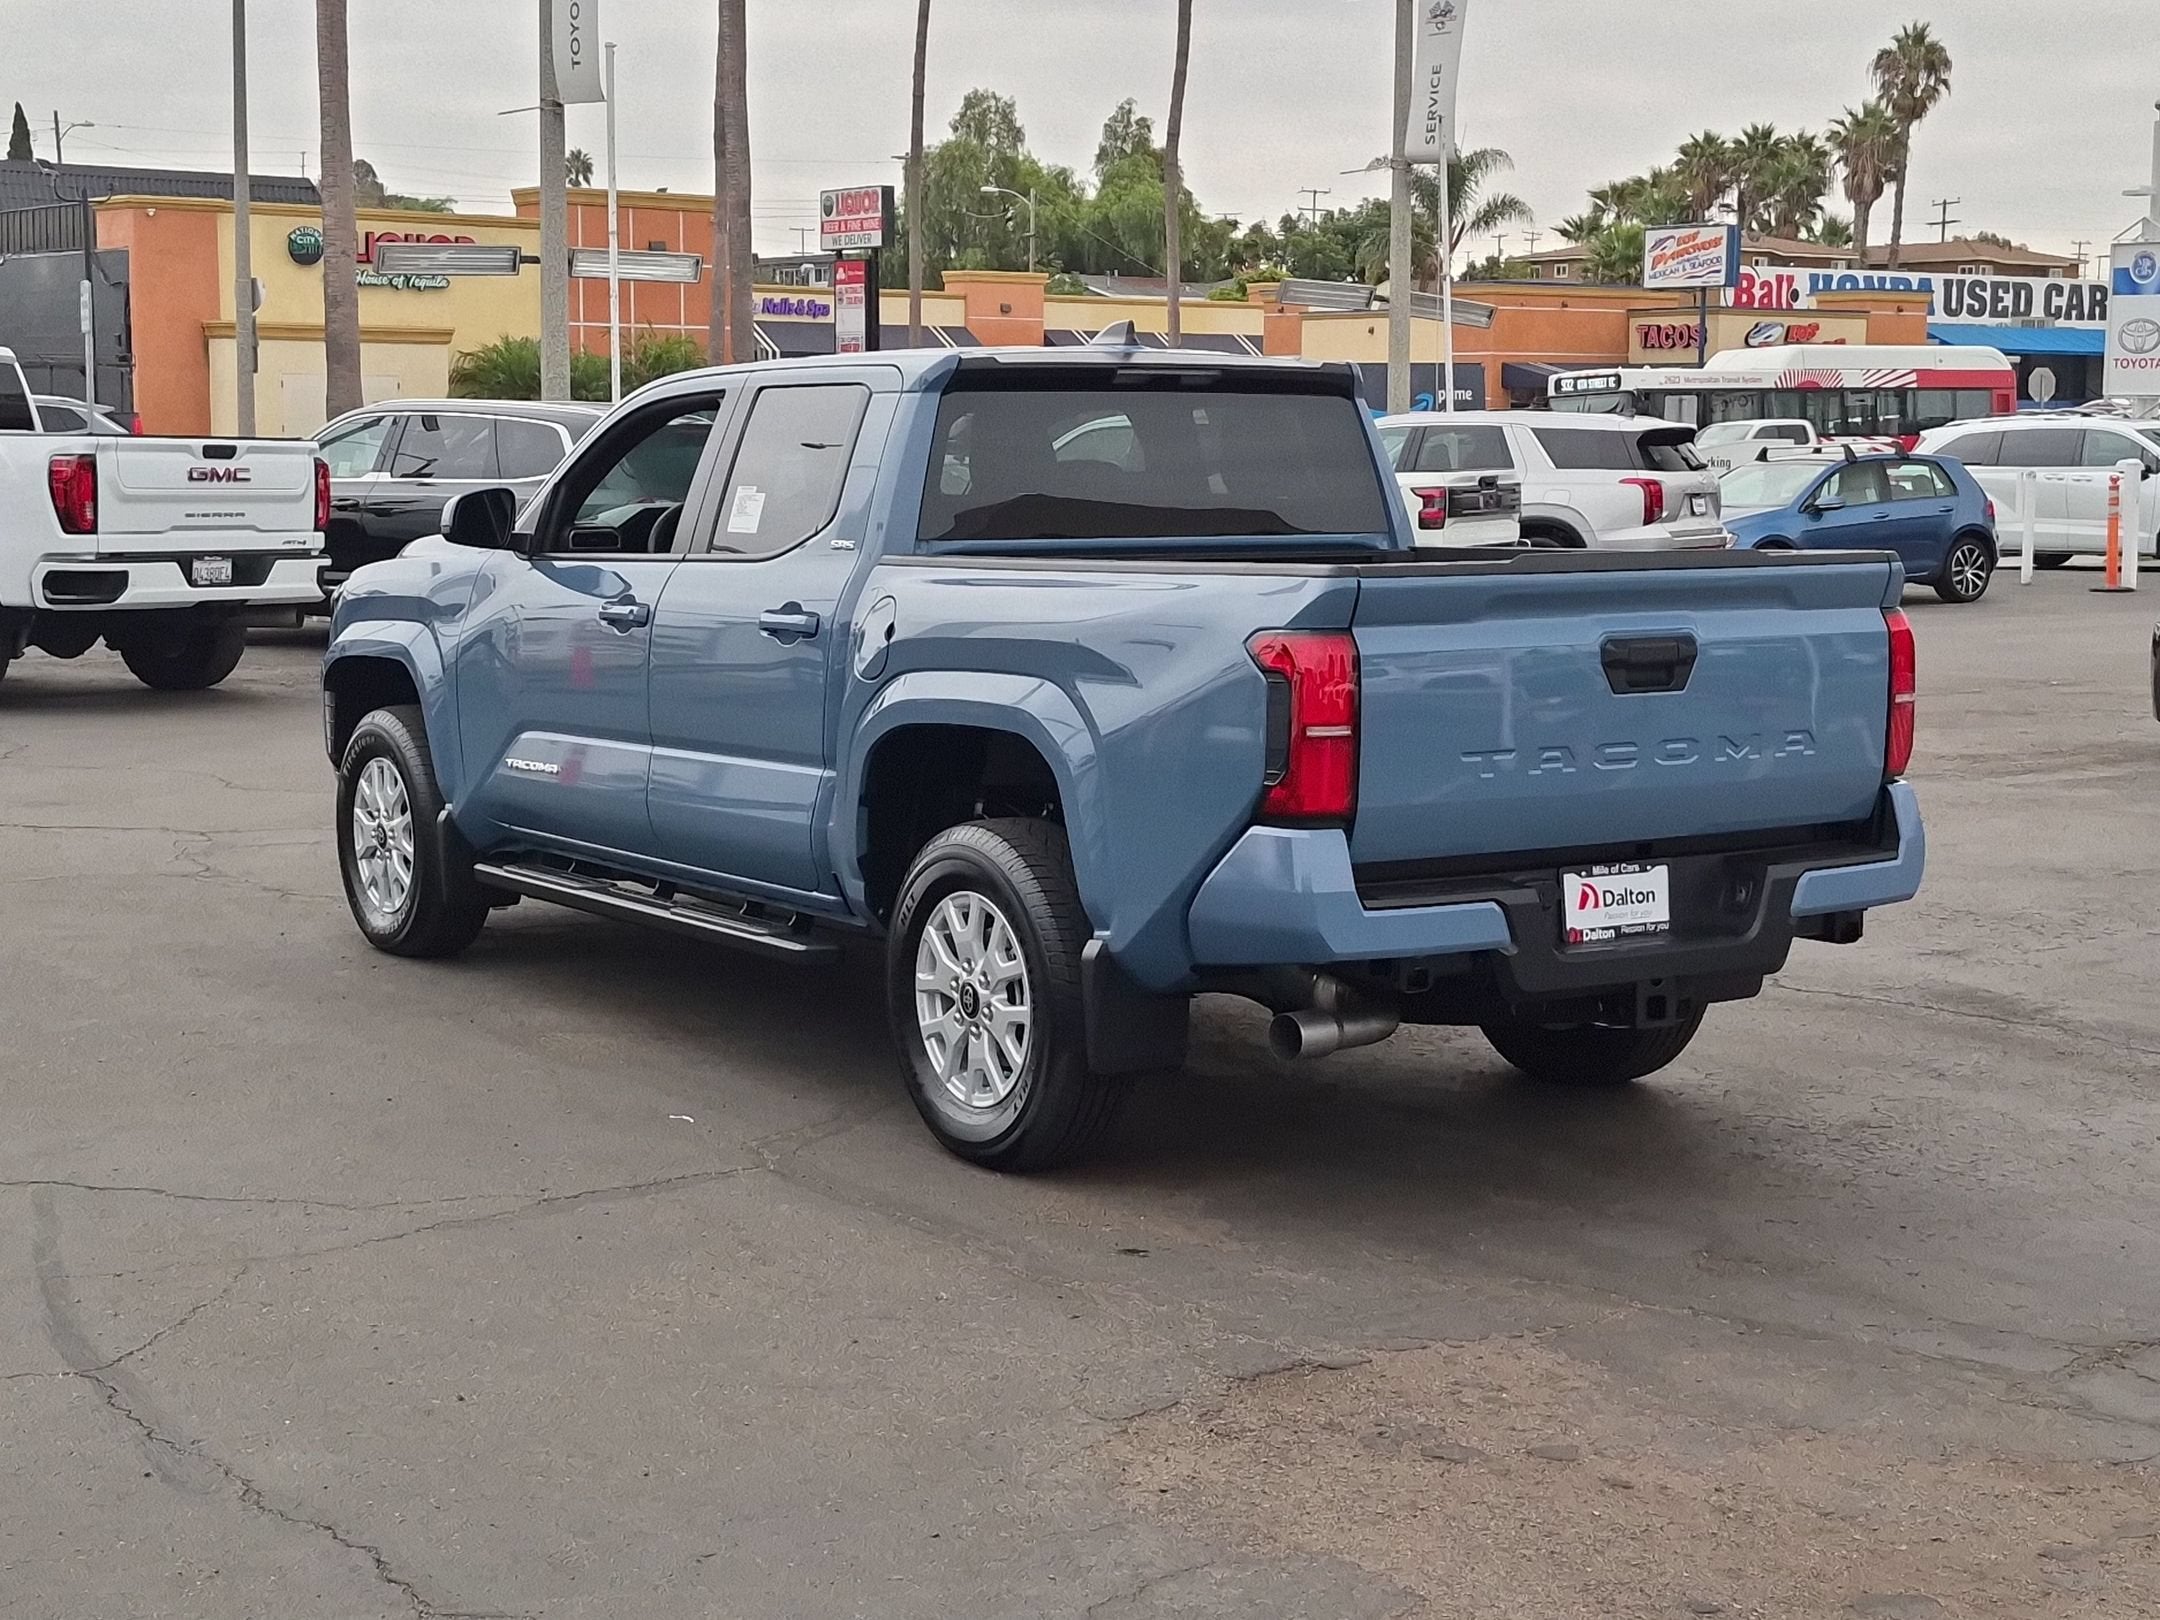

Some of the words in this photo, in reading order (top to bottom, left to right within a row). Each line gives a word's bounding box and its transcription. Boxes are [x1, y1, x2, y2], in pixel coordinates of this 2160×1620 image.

[570, 0, 581, 70] TOYO
[1425, 63, 1442, 145] SERVICE
[836, 189, 880, 217] LIQUOR
[824, 221, 839, 233] BEER
[847, 219, 861, 231] FINE
[863, 218, 880, 230] WINE
[289, 227, 323, 247] NATIONA
[296, 235, 315, 244] CITY
[832, 235, 842, 246] WE
[844, 233, 872, 246] DELIVER
[1648, 267, 1680, 280] MEXICAN
[1690, 256, 1723, 271] SEAFOOD
[355, 269, 389, 286] House
[392, 275, 406, 290] of
[408, 275, 449, 292] Tequila
[762, 298, 795, 316] Nails
[795, 299, 805, 316] &
[806, 300, 830, 319] Spa
[1943, 278, 2034, 319] USED
[2044, 282, 2109, 321] CAR
[1636, 323, 1702, 349] TACOS
[1438, 389, 1473, 403] pme
[187, 467, 252, 483] GMC
[1461, 730, 1816, 778] TACOMA
[505, 758, 558, 774] TACOMA
[1592, 865, 1609, 876] Mile
[1611, 864, 1619, 874] of
[1621, 863, 1640, 873] Cars
[1602, 887, 1656, 908] Dalton
[1630, 909, 1639, 918] for
[1639, 909, 1653, 919] you
[1583, 928, 1615, 941] Dalton
[1620, 924, 1645, 934] Passion
[1646, 922, 1656, 932] for
[1656, 922, 1670, 932] you
